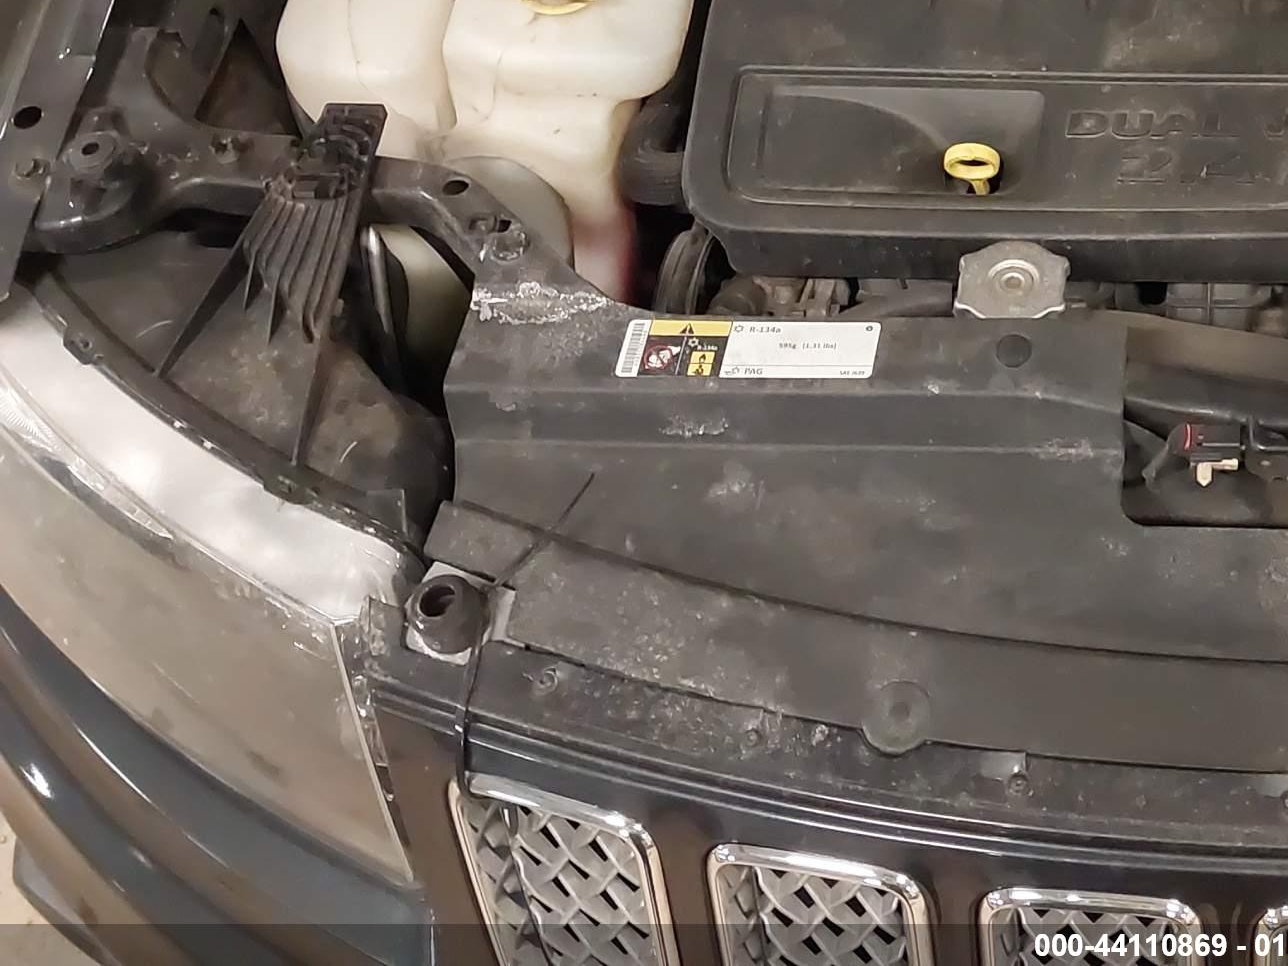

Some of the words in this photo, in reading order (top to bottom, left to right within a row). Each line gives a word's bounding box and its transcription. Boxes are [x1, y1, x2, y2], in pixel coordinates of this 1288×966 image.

[1065, 109, 1241, 138] DUAL
[749, 326, 782, 334] R-134a
[744, 367, 763, 376] PAG
